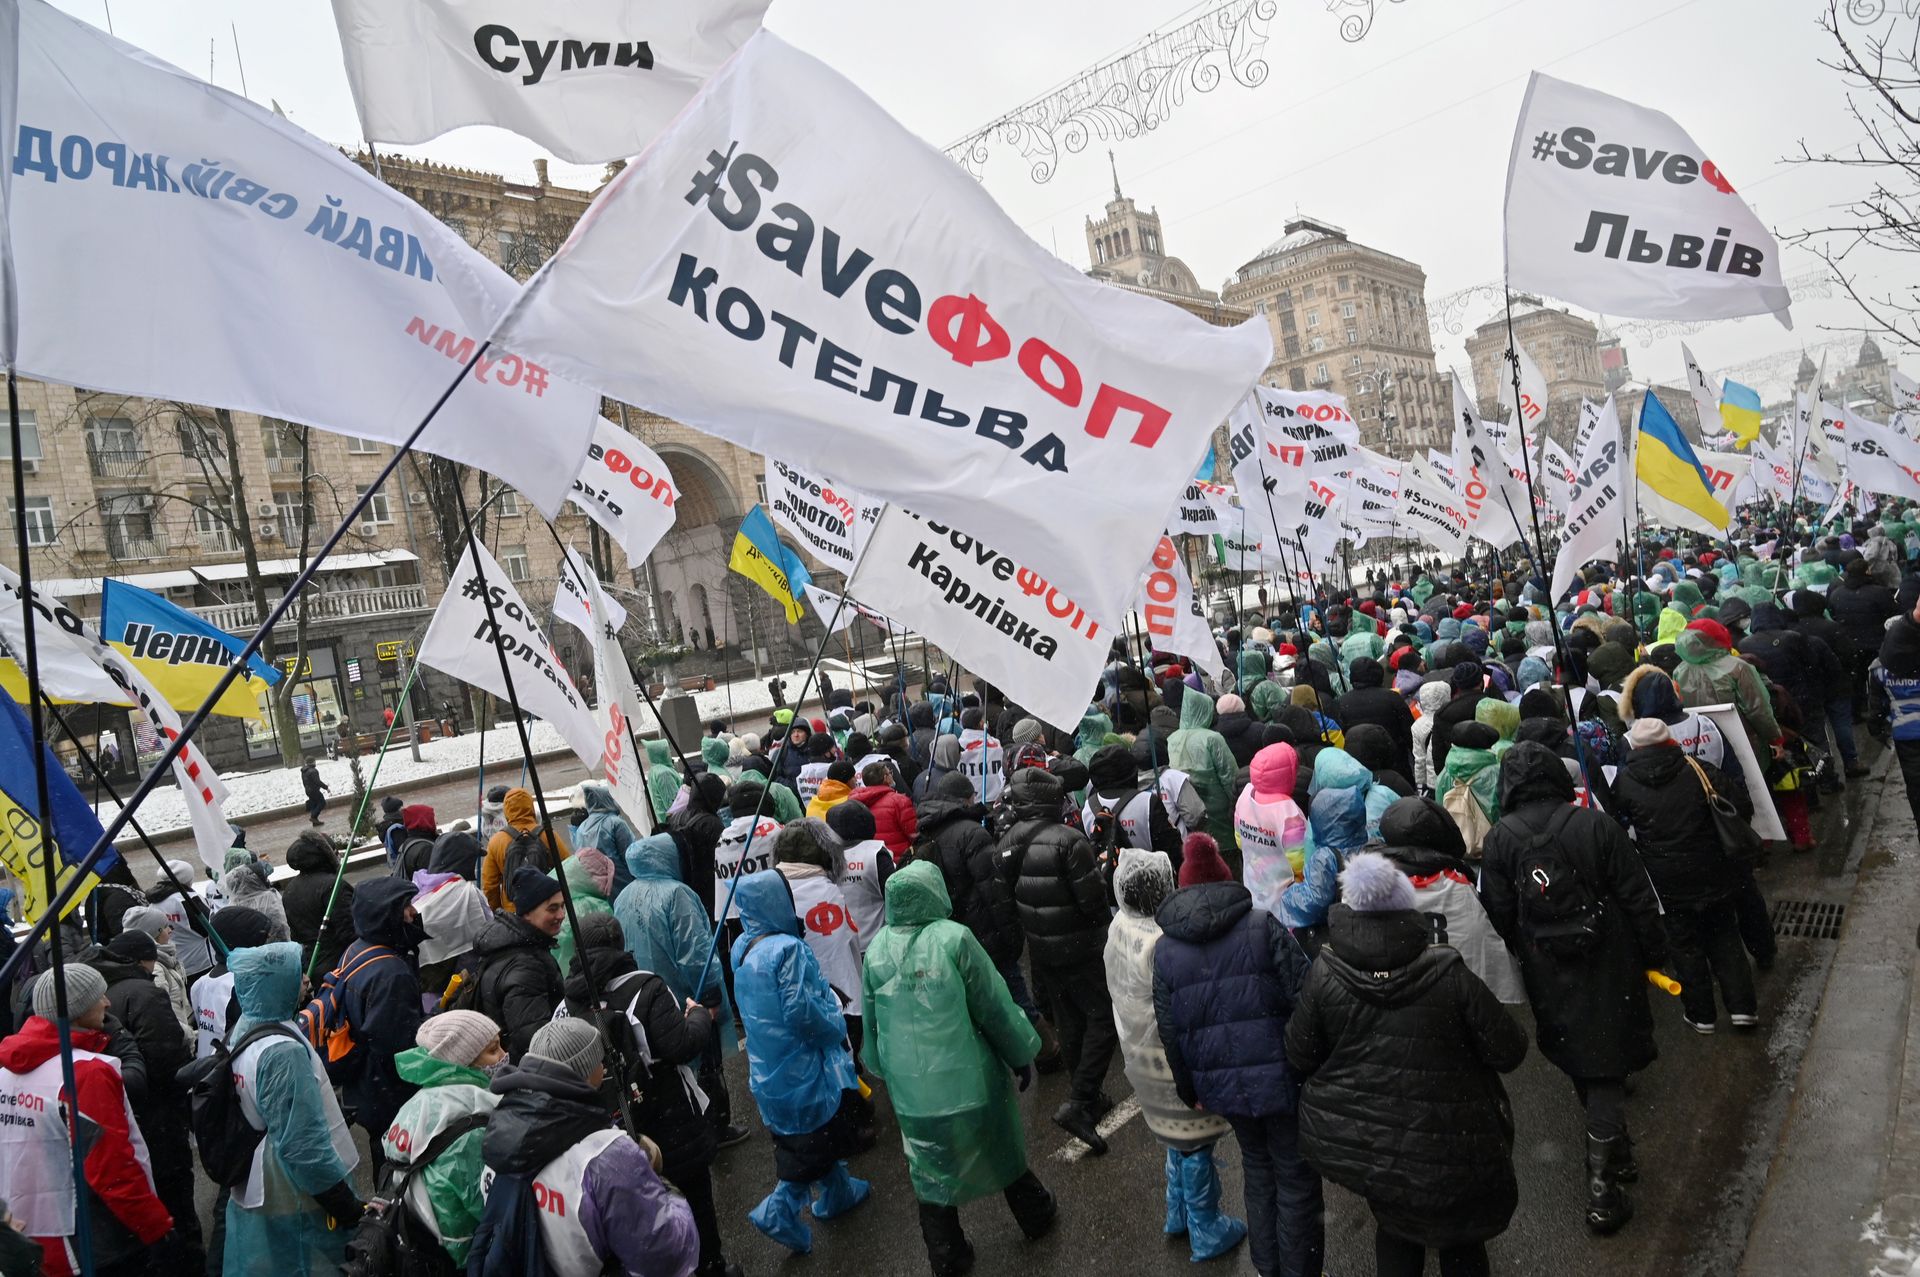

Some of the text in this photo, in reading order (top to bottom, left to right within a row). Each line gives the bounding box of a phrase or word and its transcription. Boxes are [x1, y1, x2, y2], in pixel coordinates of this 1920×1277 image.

[473, 24, 654, 85] Суми
[1574, 210, 1764, 278] Львів
[684, 140, 1172, 448] #SaveФОП
[667, 252, 1069, 474] КОТЕЛЬВА
[907, 541, 1058, 661] Карлівка
[0, 1090, 44, 1112] aveФОП
